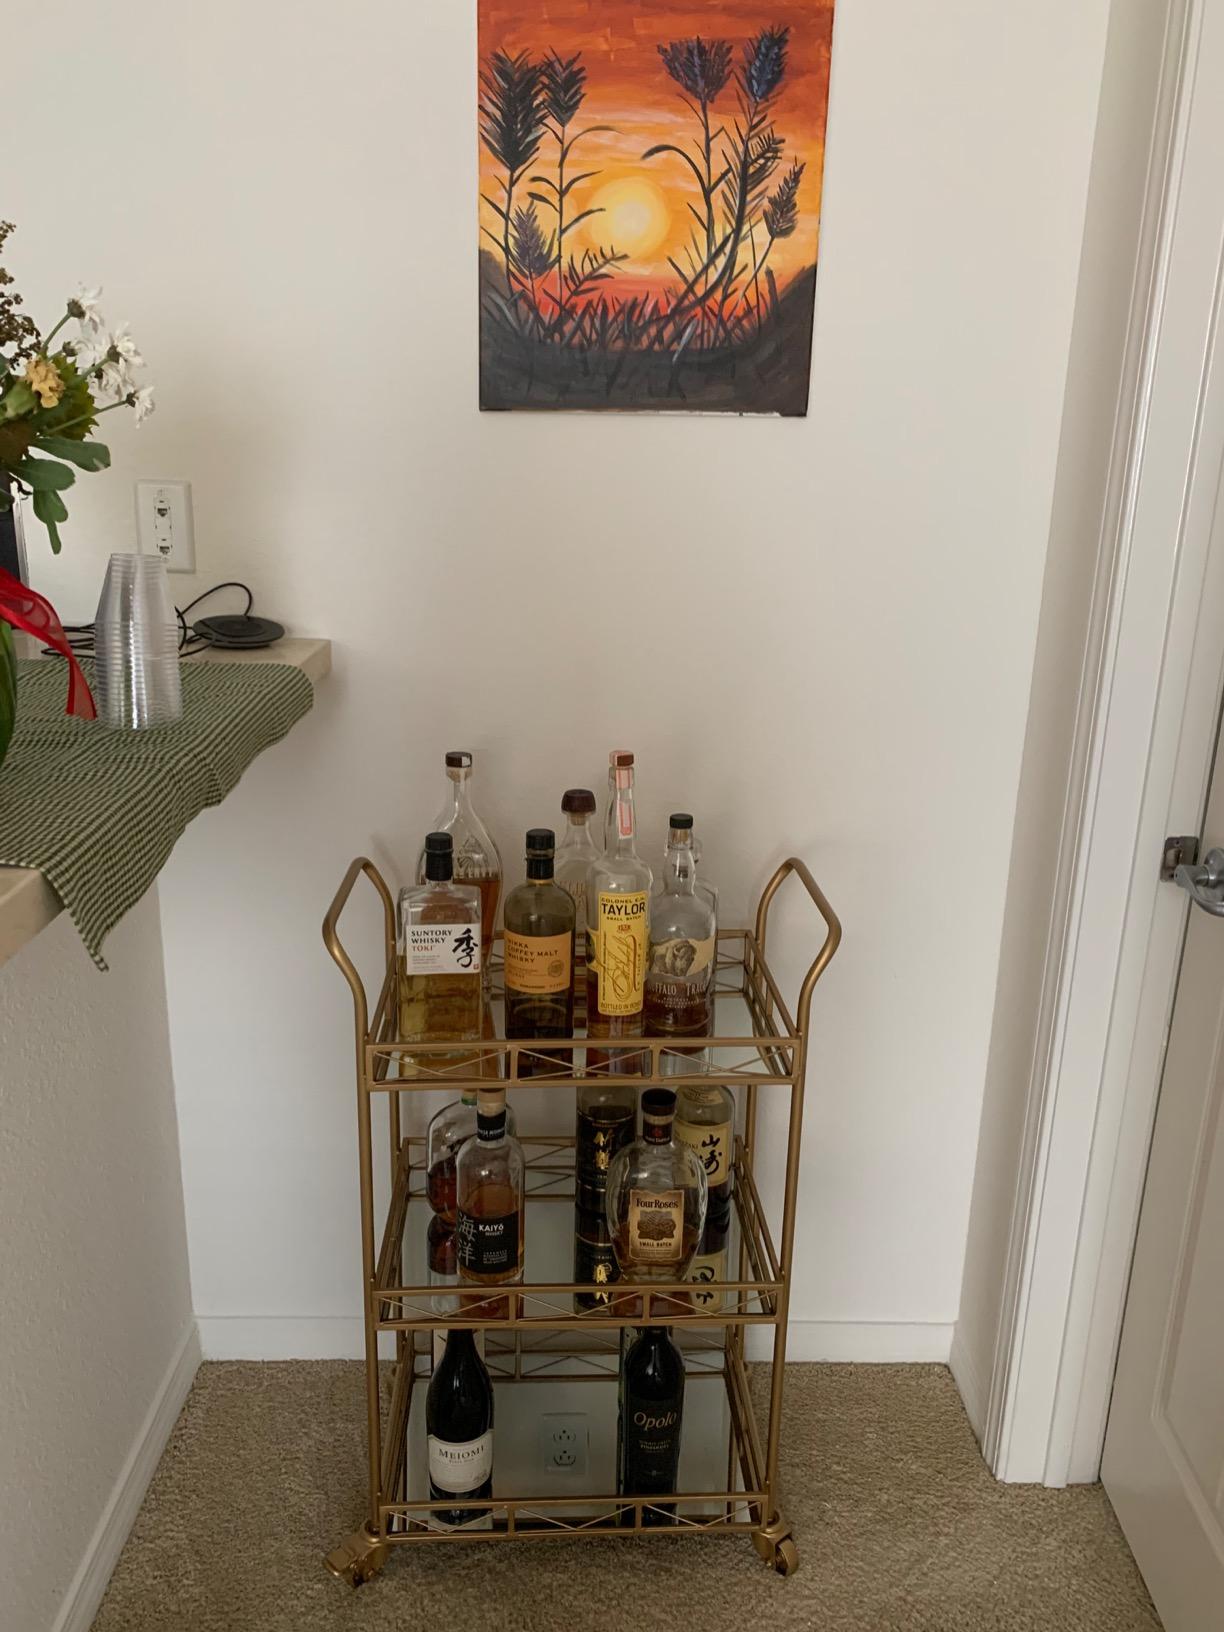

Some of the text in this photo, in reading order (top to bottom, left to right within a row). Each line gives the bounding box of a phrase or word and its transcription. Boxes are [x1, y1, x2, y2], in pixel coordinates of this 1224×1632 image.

[601, 901, 646, 916] TAYLOR
[411, 929, 453, 937] SUNTORY
[411, 937, 446, 945] WHISKY
[412, 945, 433, 953] TOKI
[537, 949, 559, 957] MALT
